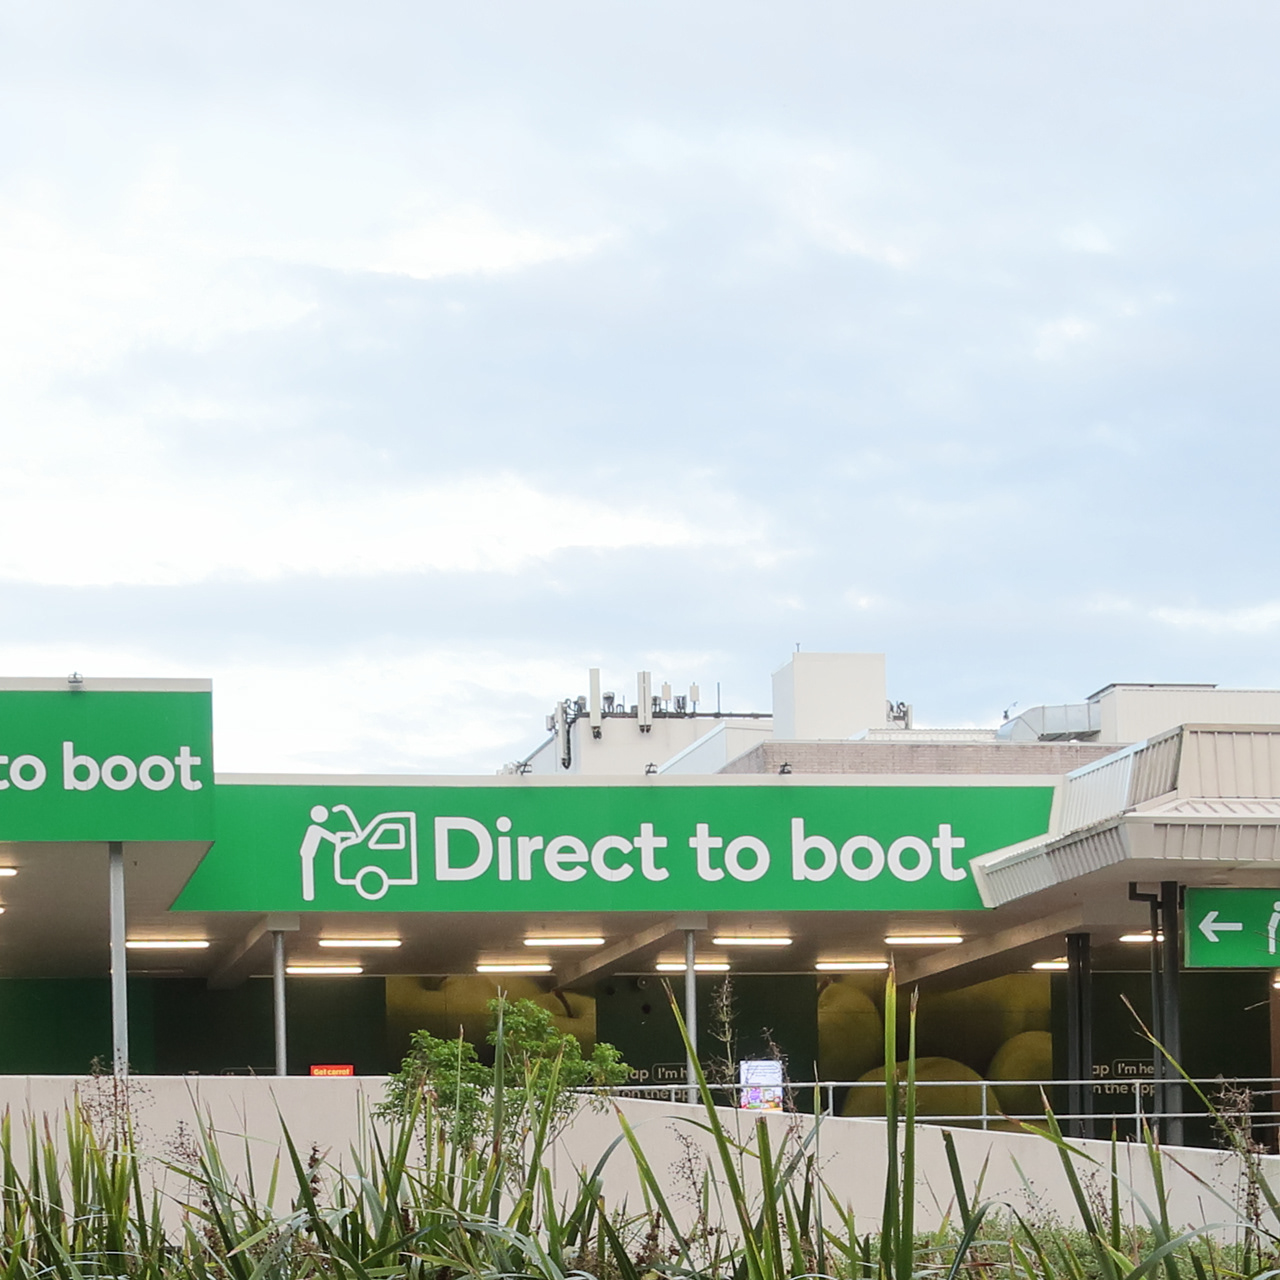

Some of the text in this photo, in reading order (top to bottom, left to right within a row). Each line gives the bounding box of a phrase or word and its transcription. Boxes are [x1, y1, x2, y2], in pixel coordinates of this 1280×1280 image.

[62, 741, 203, 791] boot
[434, 816, 968, 882] Direct to boot
[658, 1067, 678, 1079] I'm
[1117, 1063, 1137, 1074] I'm
